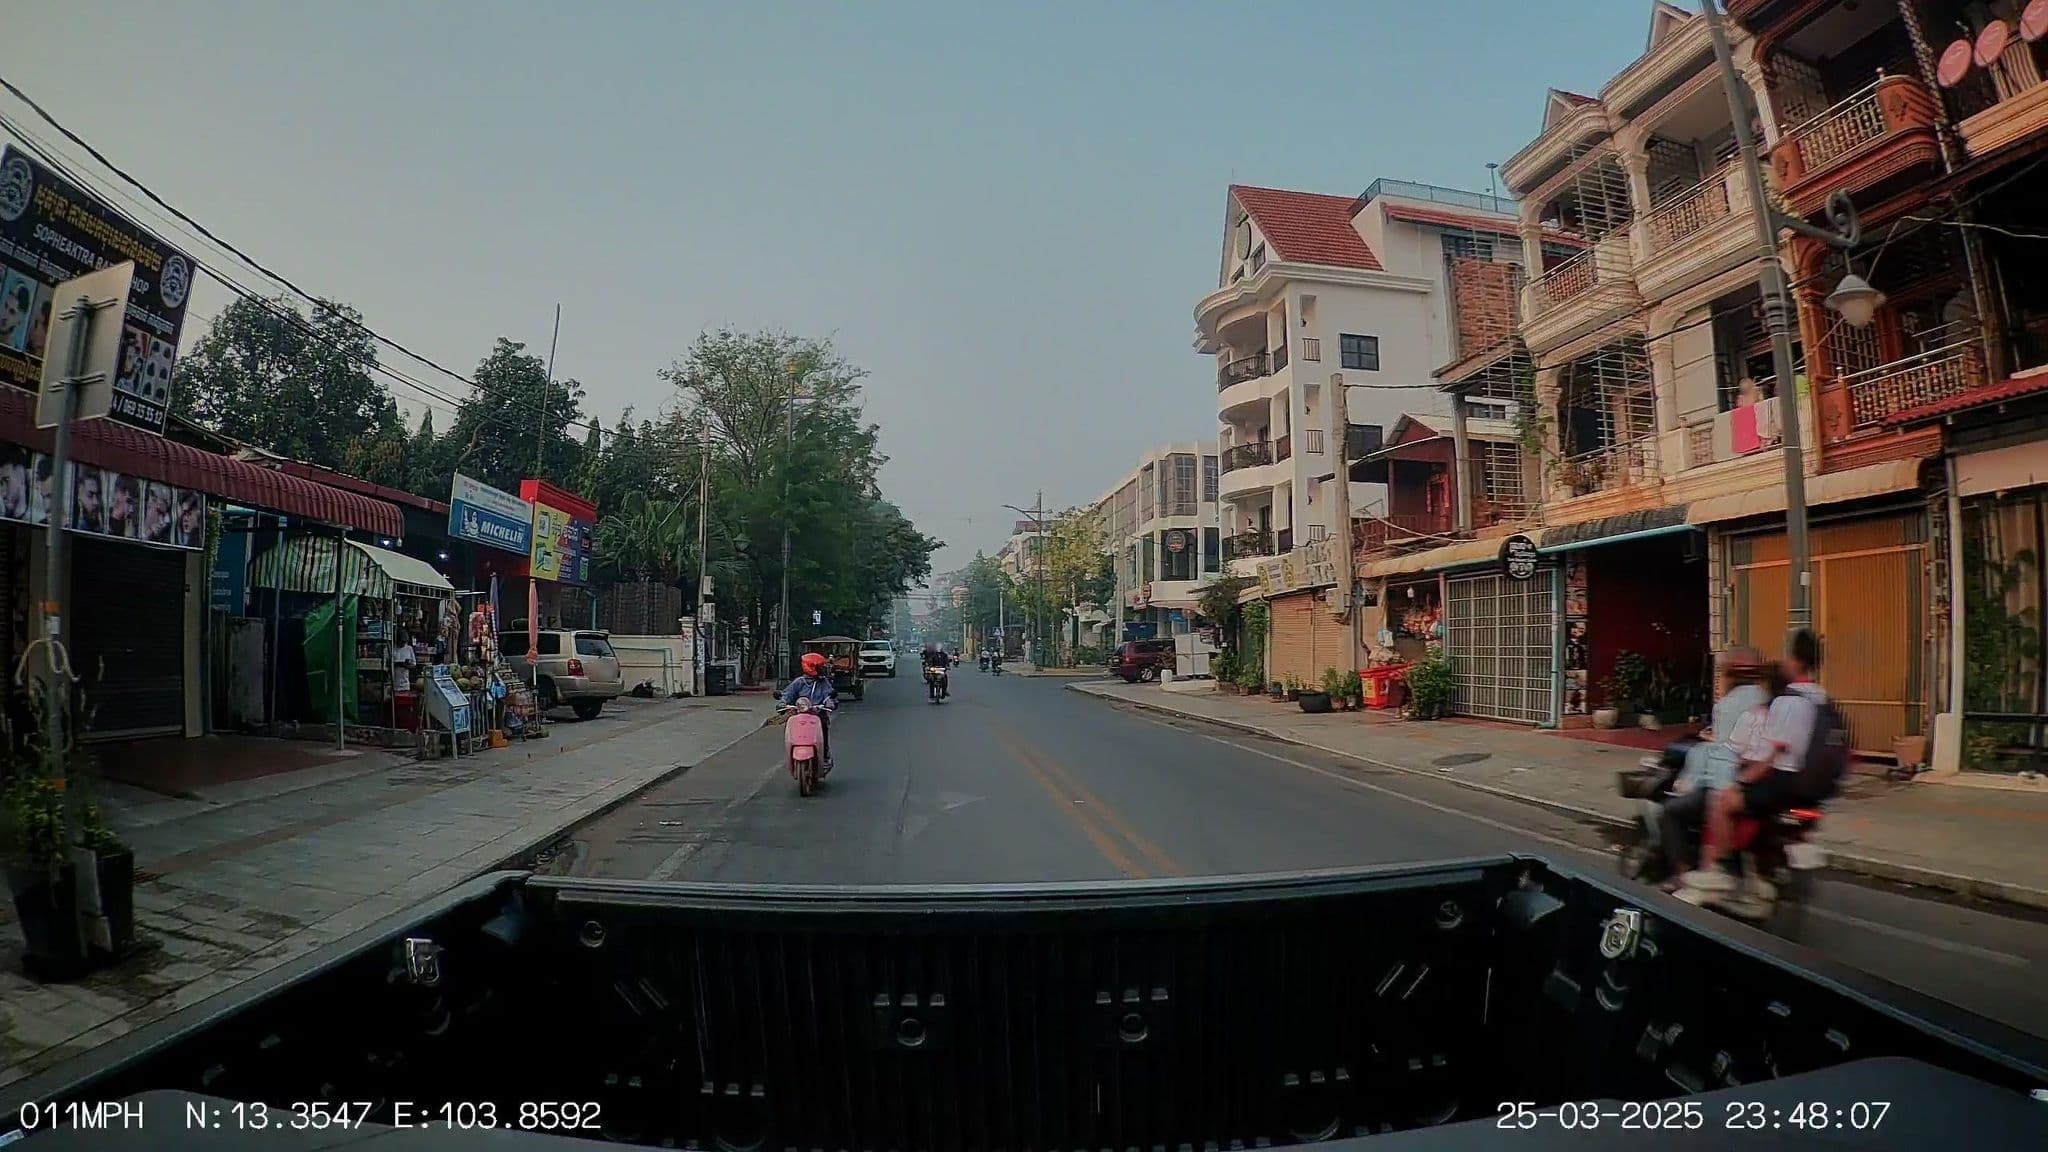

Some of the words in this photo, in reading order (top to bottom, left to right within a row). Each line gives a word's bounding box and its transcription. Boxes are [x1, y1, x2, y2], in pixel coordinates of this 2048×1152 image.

[33, 223, 96, 268] SOPHEAKTRA
[131, 275, 150, 295] HOP
[480, 521, 524, 544] MICHELIN
